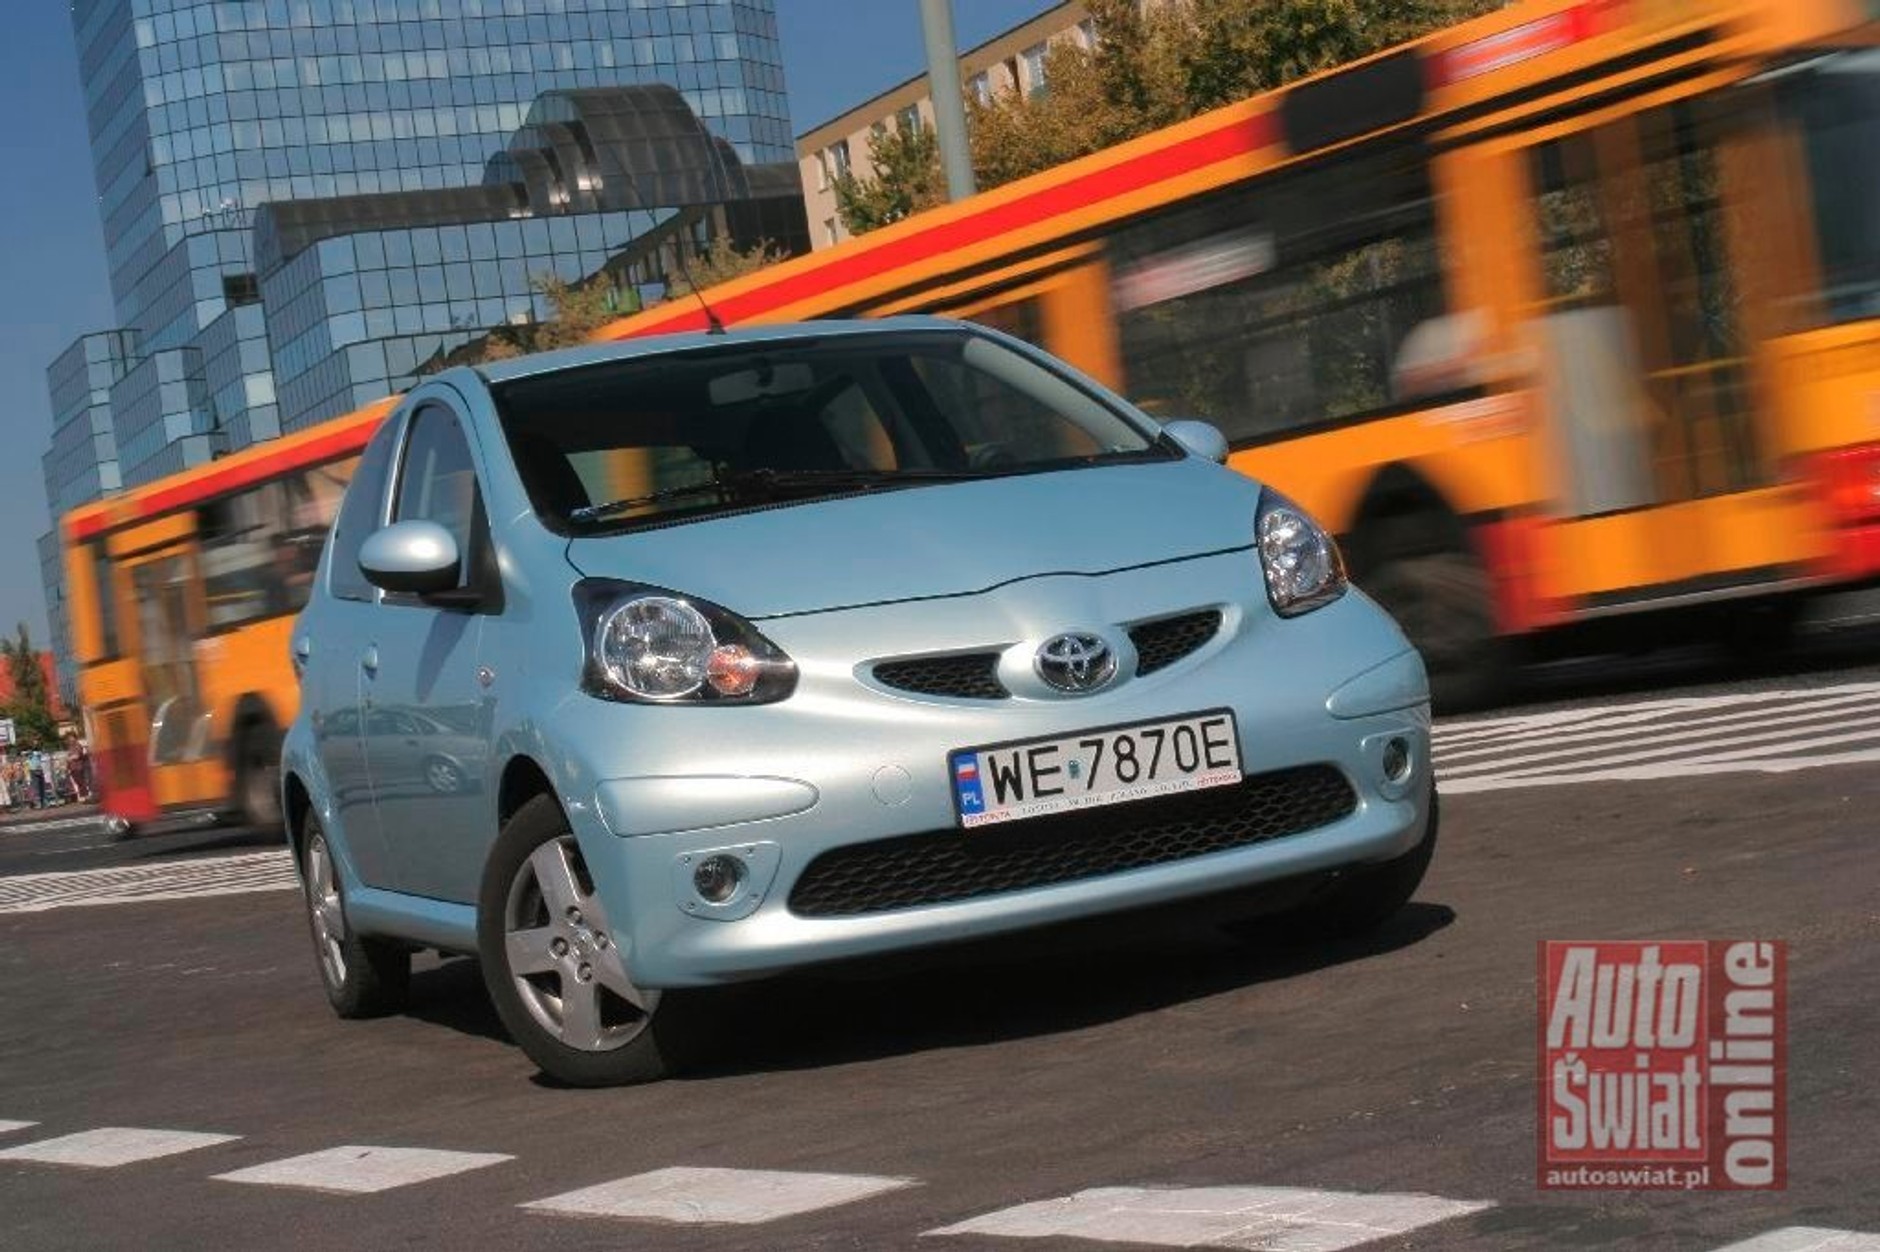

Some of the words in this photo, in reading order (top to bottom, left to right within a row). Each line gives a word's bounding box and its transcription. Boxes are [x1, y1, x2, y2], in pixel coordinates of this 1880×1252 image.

[988, 745, 1064, 804] WE
[1079, 718, 1232, 790] 7870E
[961, 791, 981, 806] PL
